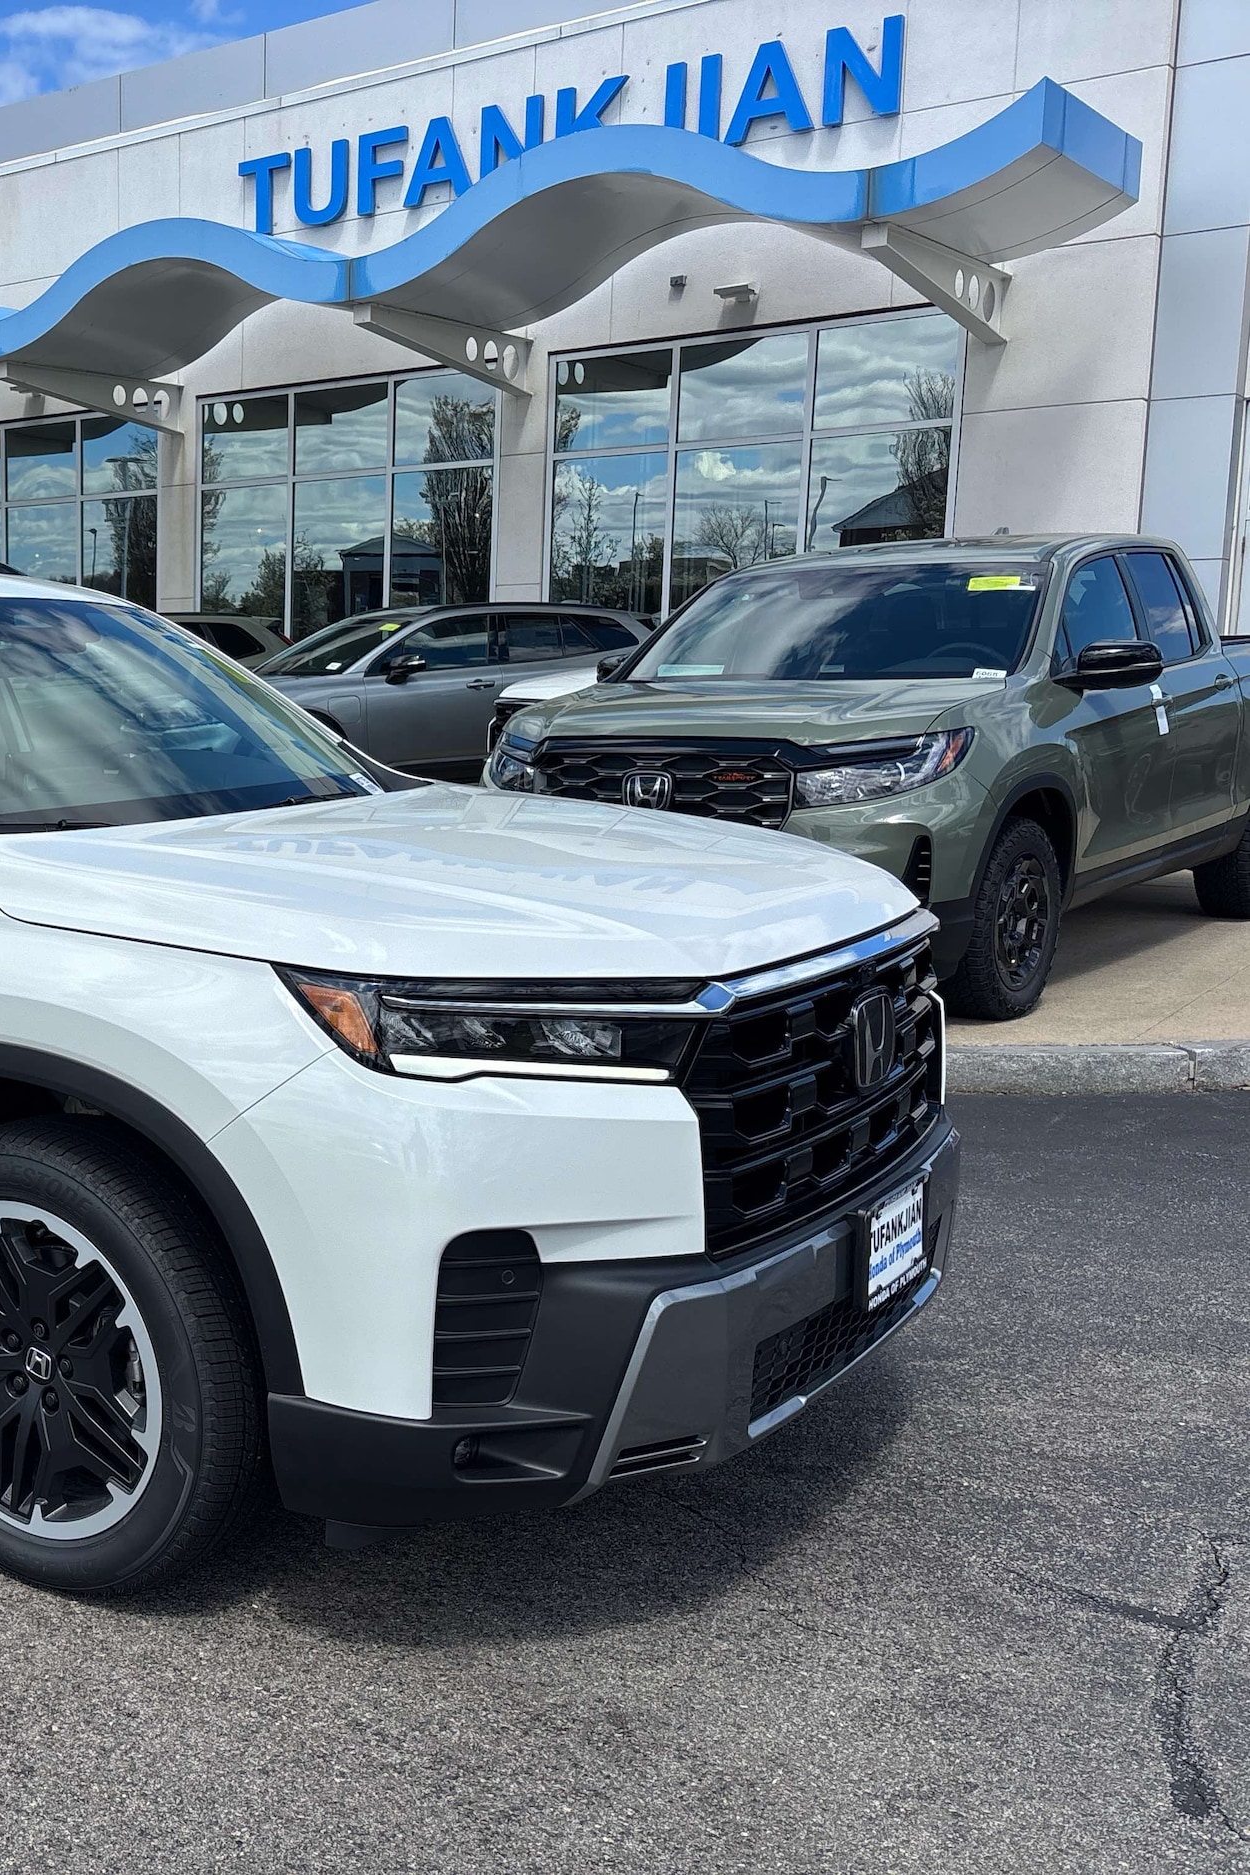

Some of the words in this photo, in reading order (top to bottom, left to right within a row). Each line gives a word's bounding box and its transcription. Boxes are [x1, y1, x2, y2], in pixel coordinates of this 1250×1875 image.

[871, 1198, 922, 1254] UFANKJIAN
[889, 1248, 895, 1265] of
[896, 1229, 921, 1259] Plymouth
[868, 1288, 890, 1312] HONDA
[891, 1280, 900, 1294] OF
[900, 1258, 927, 1289] PLYMOUTH
